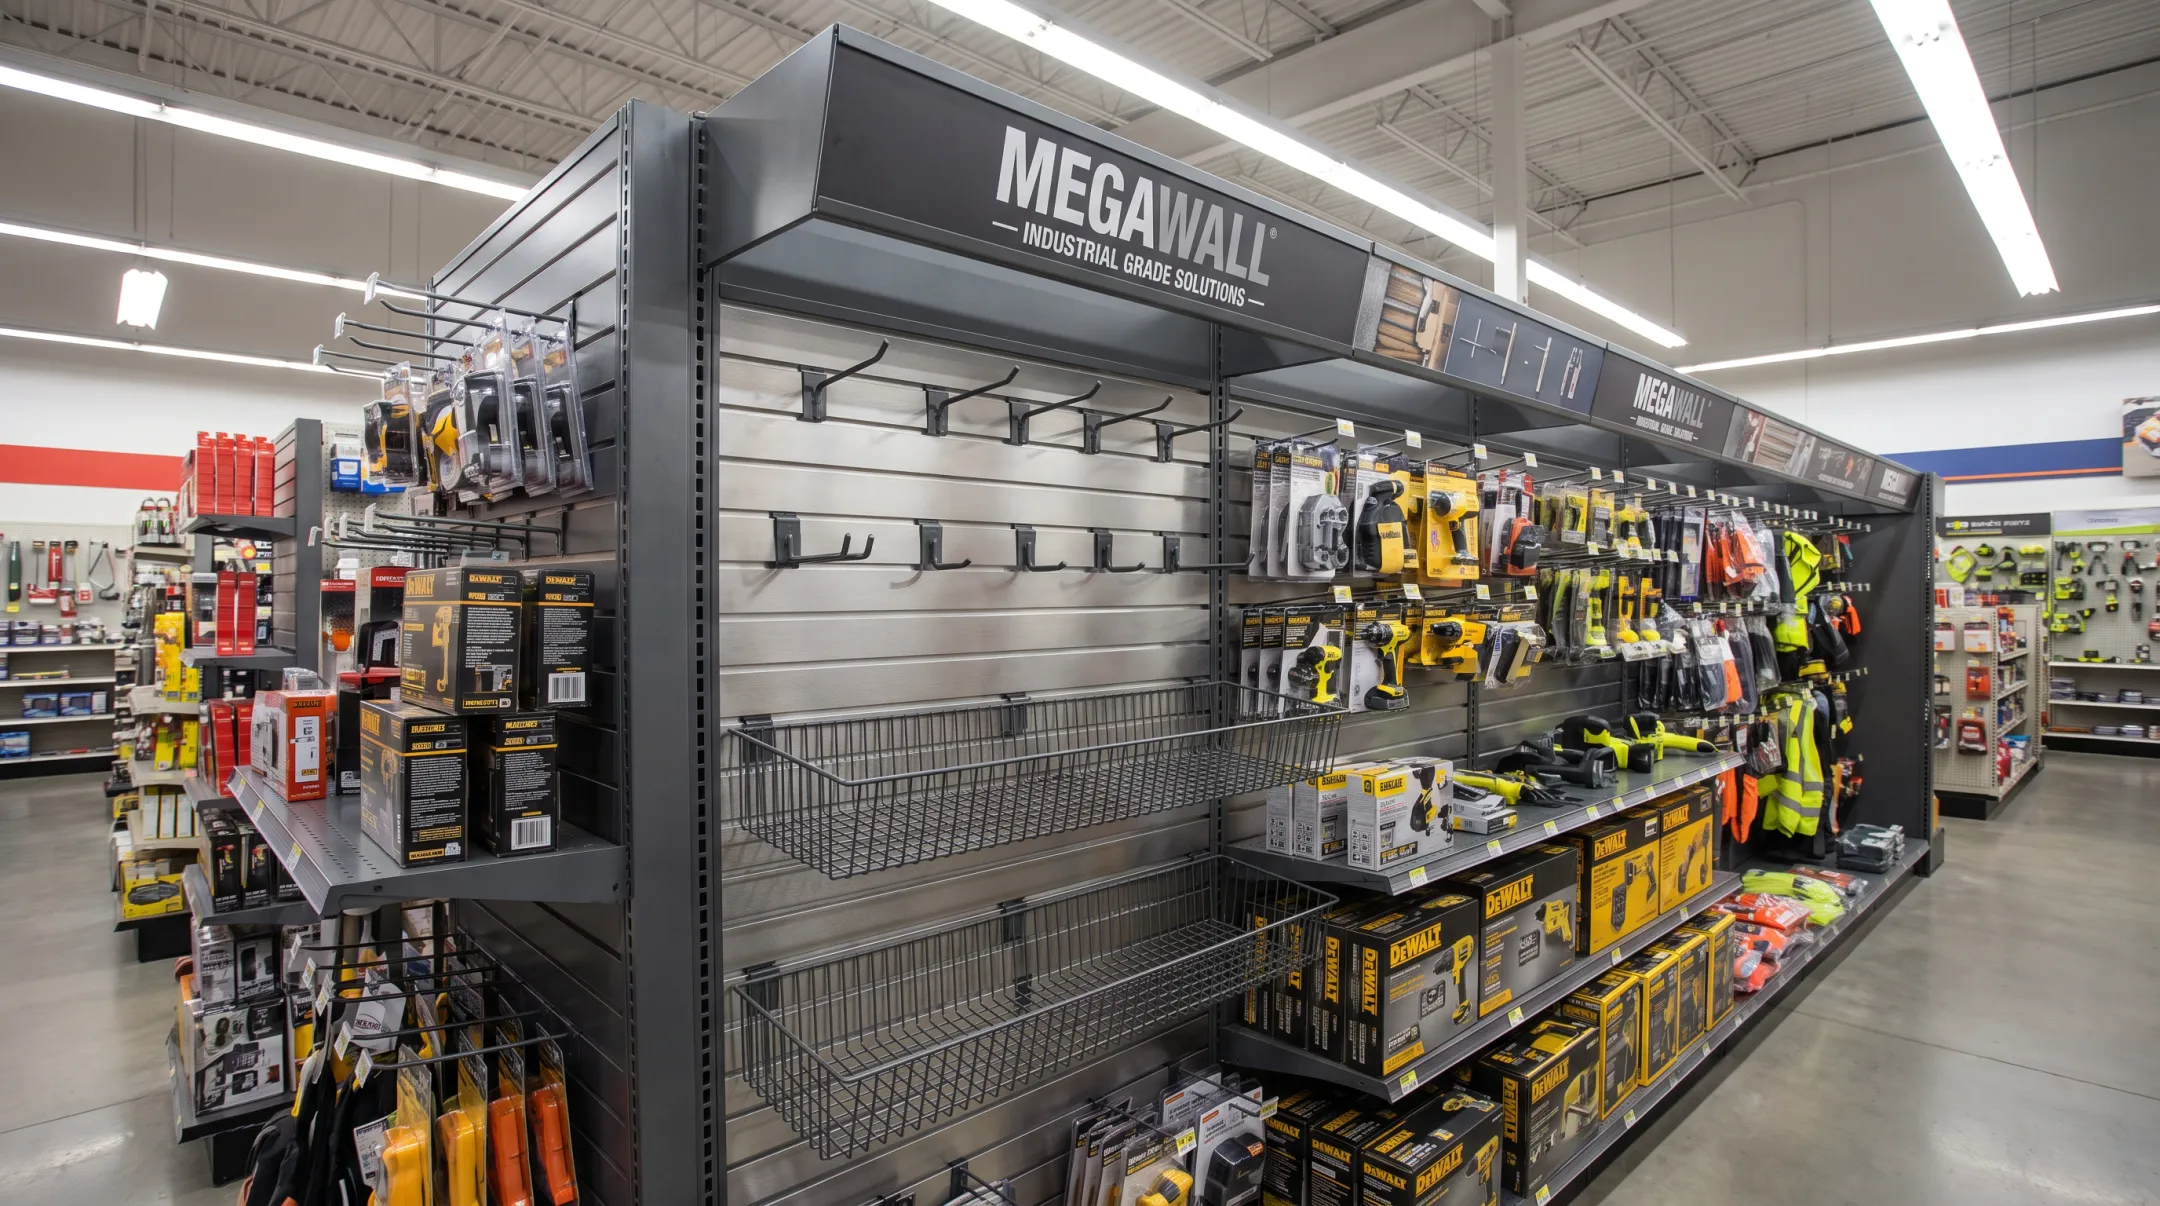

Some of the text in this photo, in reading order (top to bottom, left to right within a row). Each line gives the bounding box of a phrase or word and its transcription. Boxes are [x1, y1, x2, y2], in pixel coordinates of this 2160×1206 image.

[1023, 221, 1246, 307] INDUSTRIAL GRADE SOLUTIONS
[1633, 372, 1706, 429] MEGAWALL
[1595, 832, 1627, 860] DEWALT
[1486, 877, 1533, 917] DEWALT
[1326, 936, 1338, 1003] DEWALT
[1390, 926, 1441, 966] DEWALT
[1363, 947, 1377, 1015] DEWALT
[1532, 1060, 1569, 1103] DEWALT
[1503, 1080, 1516, 1142] DEWALT
[1416, 1147, 1463, 1197] DEWALT
